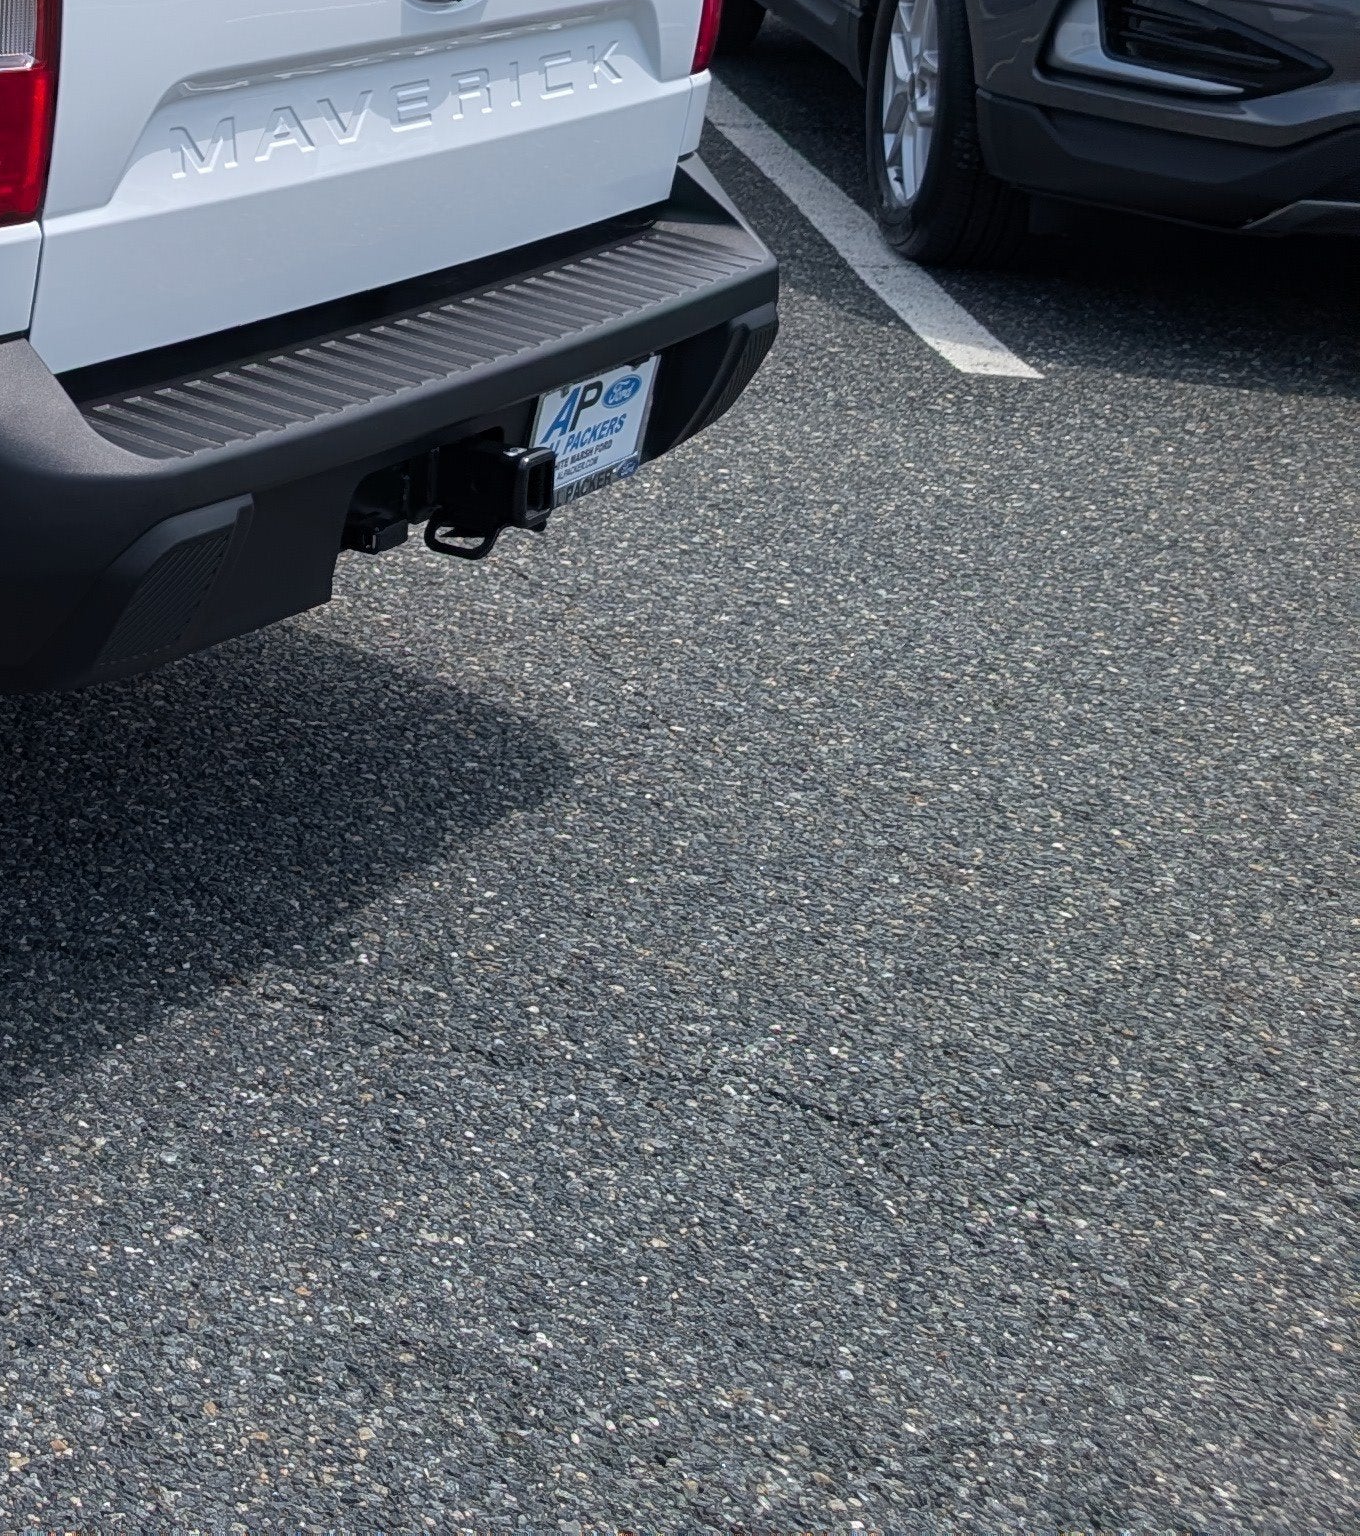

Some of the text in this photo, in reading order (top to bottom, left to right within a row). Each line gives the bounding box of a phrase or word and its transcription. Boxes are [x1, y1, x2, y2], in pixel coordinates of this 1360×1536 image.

[168, 40, 623, 179] MAVERICK
[540, 380, 604, 445] AP
[563, 413, 627, 455] PACKERS
